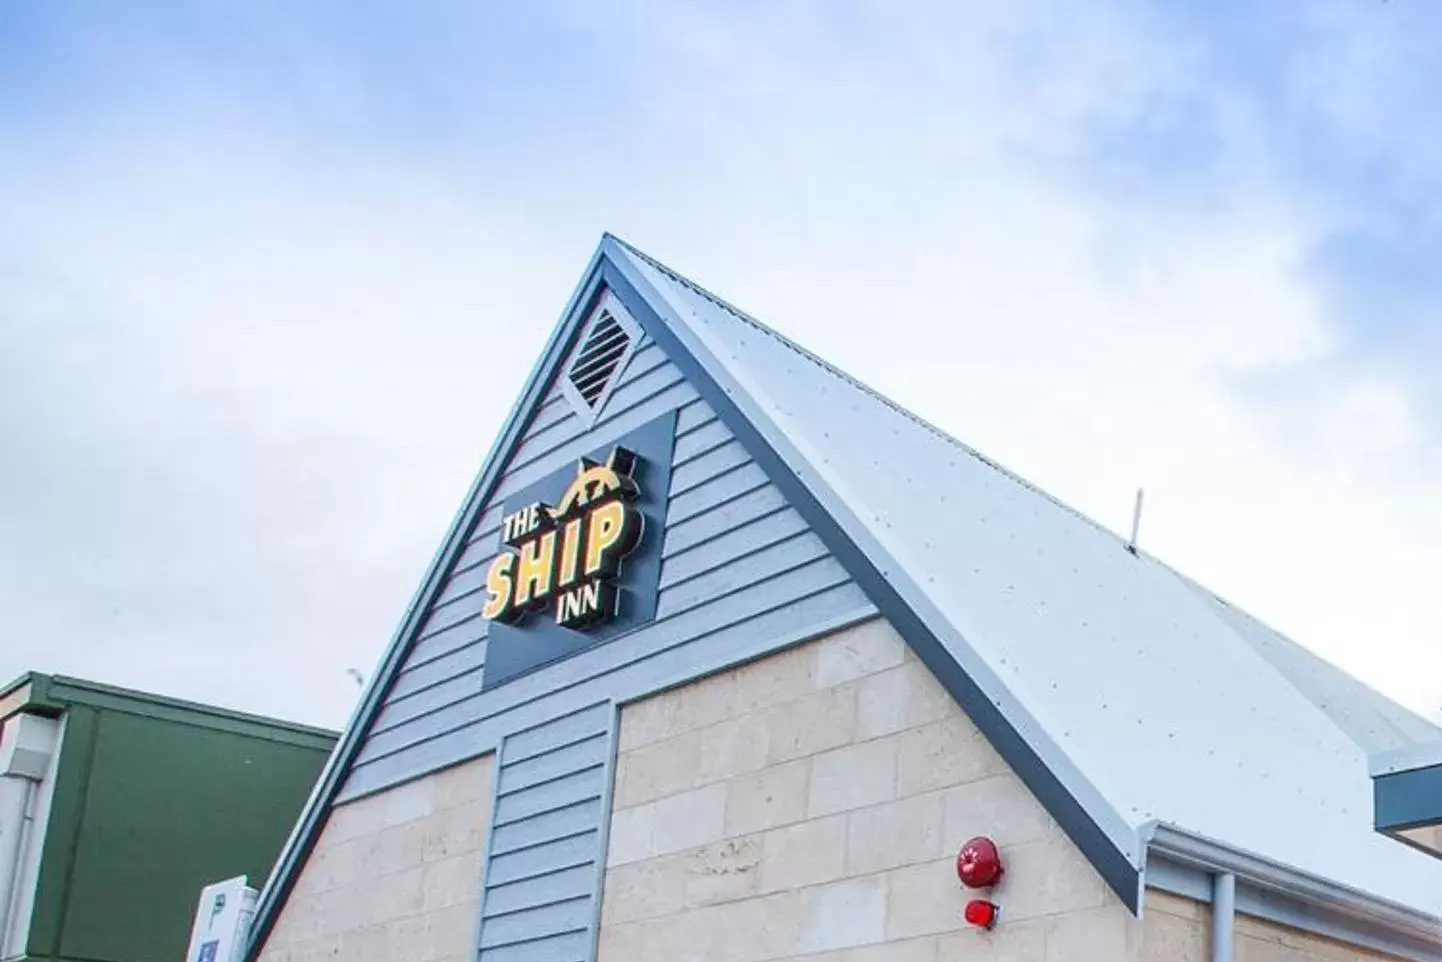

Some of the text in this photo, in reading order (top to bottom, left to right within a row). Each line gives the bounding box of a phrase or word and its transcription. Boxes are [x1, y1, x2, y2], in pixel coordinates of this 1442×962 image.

[503, 502, 540, 542] THE
[483, 502, 624, 619] SHIP
[556, 581, 601, 623] INN
